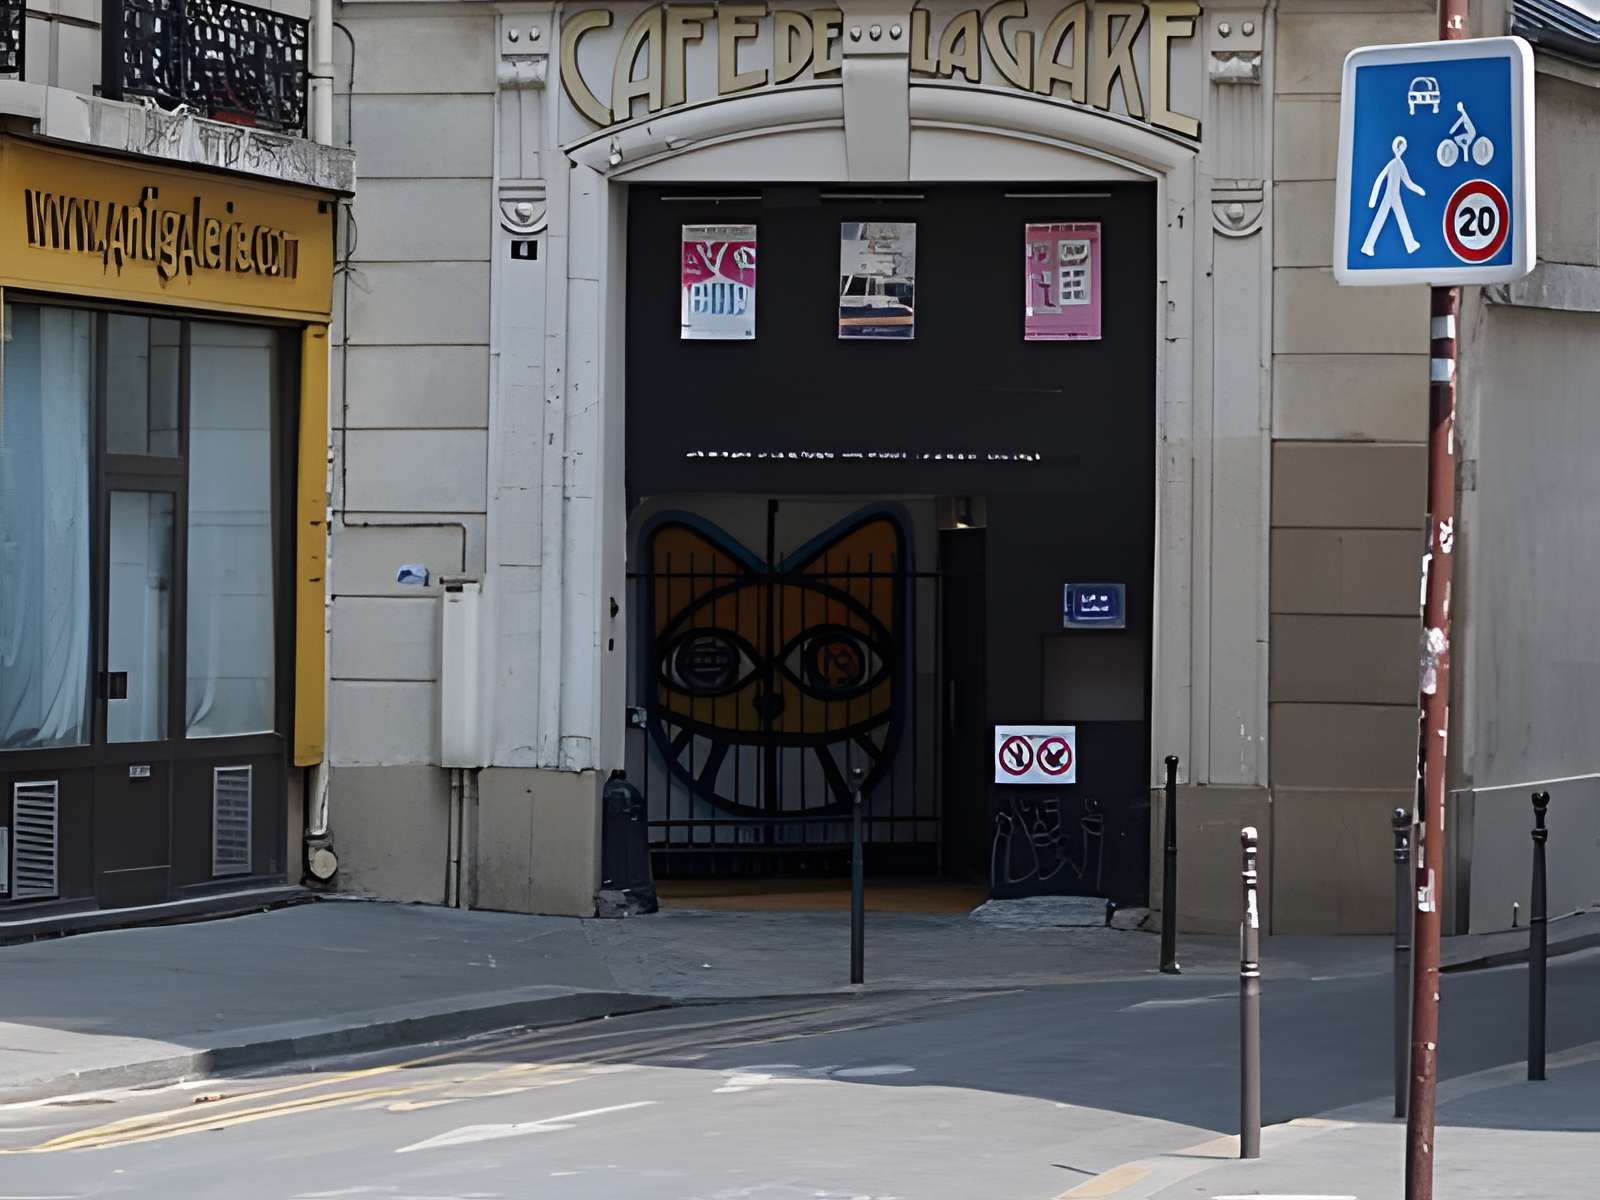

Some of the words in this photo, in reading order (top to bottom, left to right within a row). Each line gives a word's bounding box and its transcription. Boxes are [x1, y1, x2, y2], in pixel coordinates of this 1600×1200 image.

[559, 2, 769, 128] CAFE
[773, 7, 844, 86] DE
[908, 7, 982, 85] LA
[981, 0, 1204, 143] GARE
[1458, 206, 1496, 238] 20
